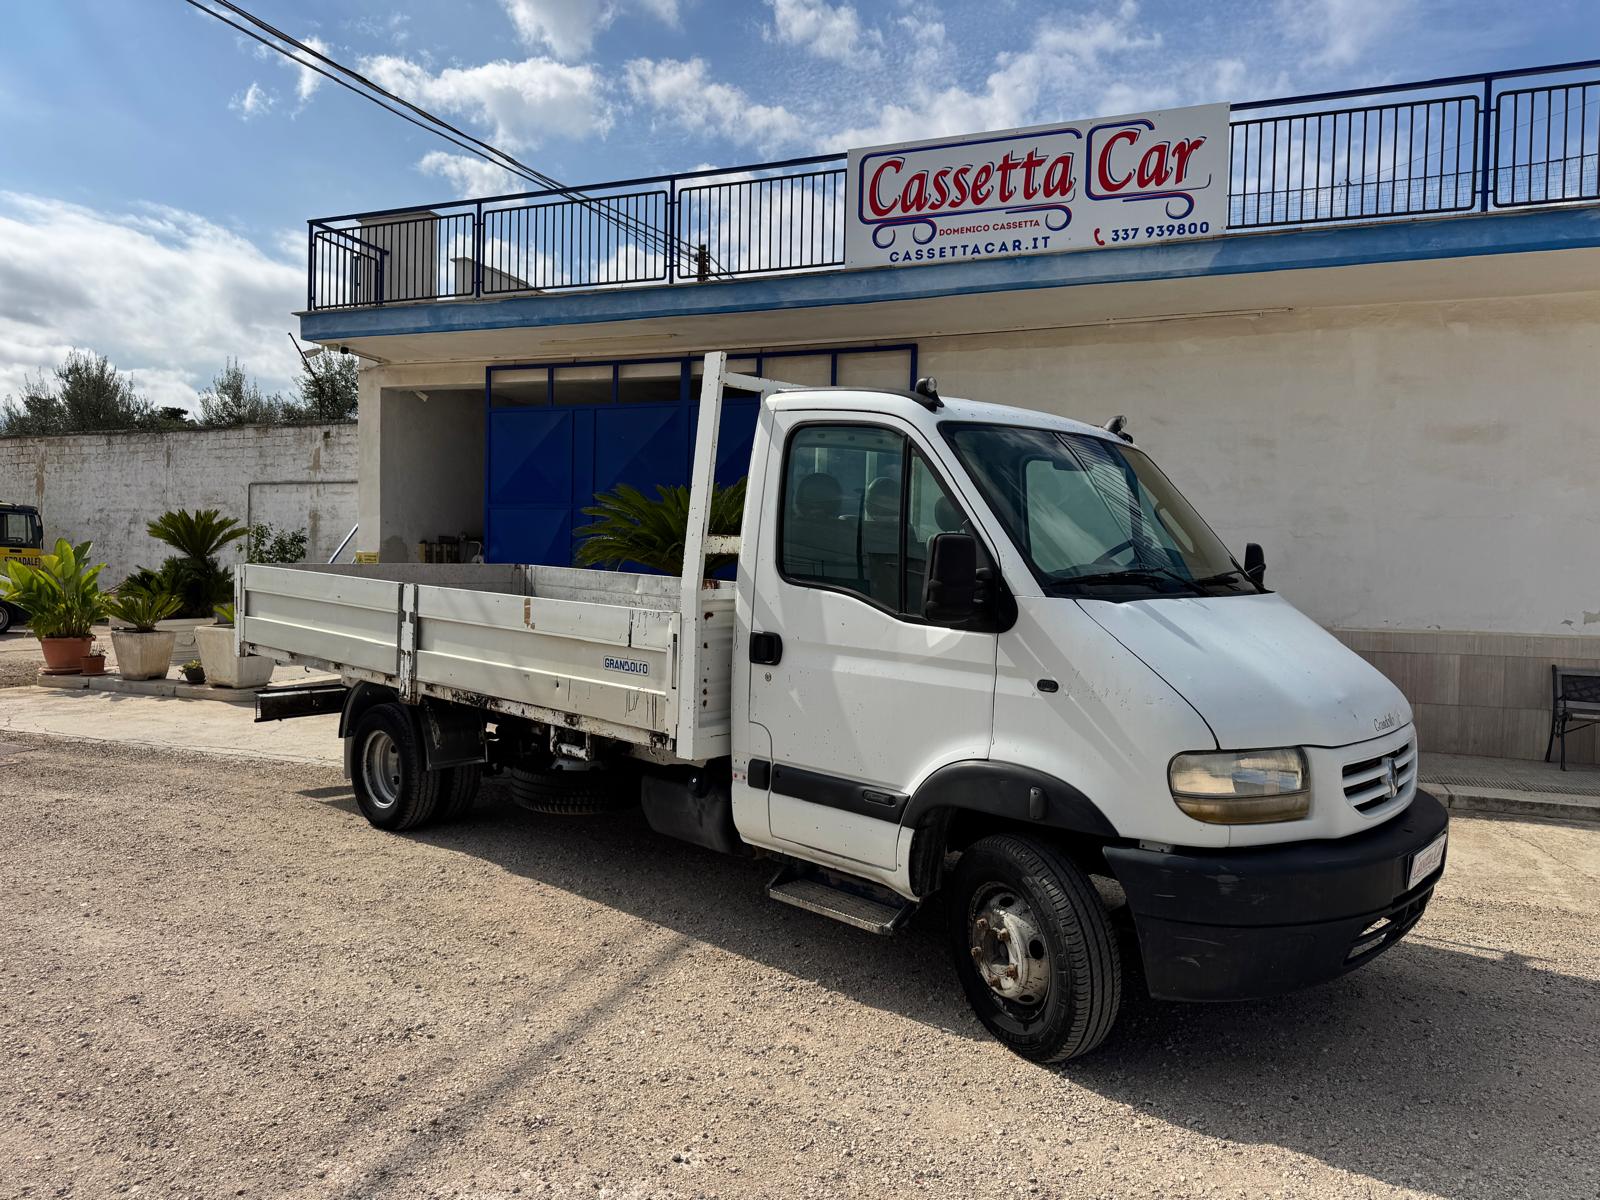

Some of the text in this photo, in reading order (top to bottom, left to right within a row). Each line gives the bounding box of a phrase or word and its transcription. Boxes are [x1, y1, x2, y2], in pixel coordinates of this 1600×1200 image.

[869, 128, 1206, 217] Cassetta Car
[939, 219, 1040, 236] DOMENICO CASSETTA
[1111, 221, 1210, 242] 337 939800
[889, 236, 1051, 263] CASSETTACAR.IT
[604, 657, 648, 674] GRANDOLFO
